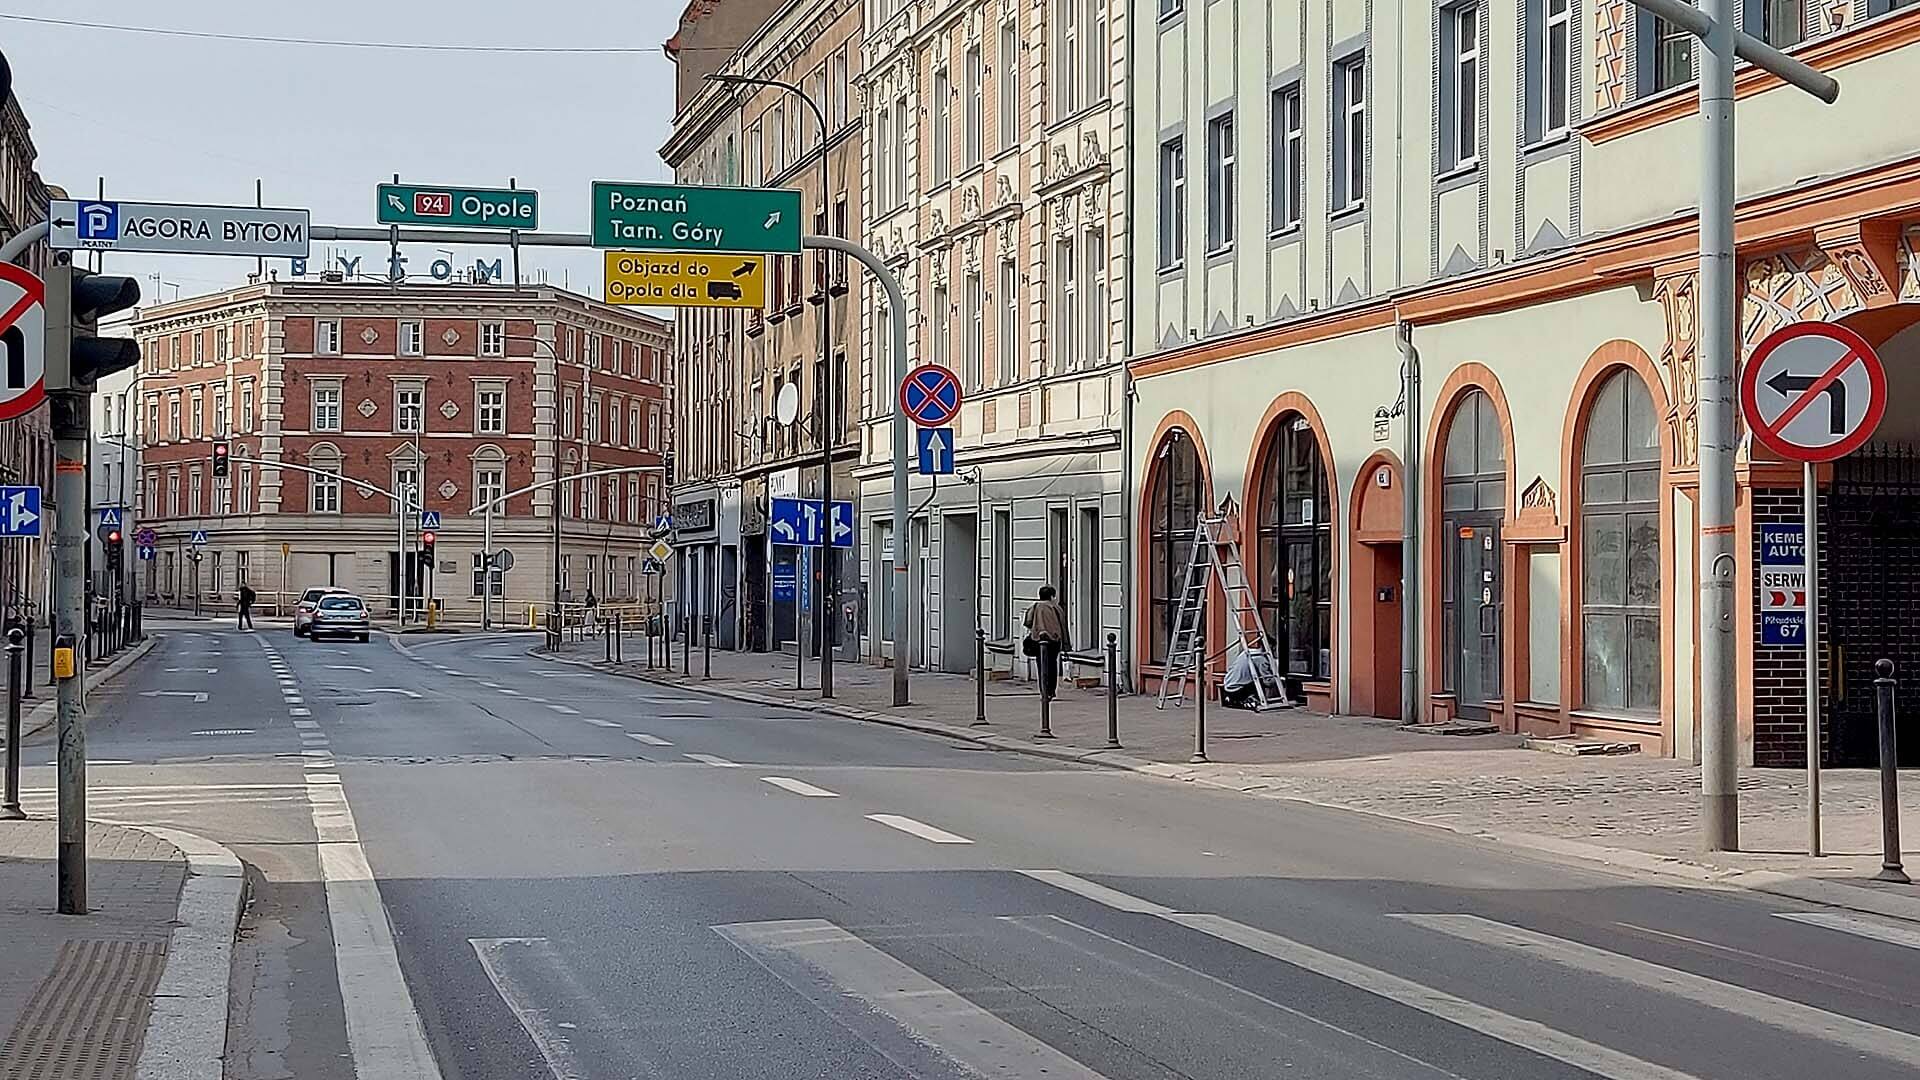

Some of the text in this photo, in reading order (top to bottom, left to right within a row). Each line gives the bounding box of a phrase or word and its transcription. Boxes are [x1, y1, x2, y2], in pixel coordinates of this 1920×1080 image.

[422, 196, 532, 222] 94 Opole
[610, 191, 687, 213] Poznań
[124, 217, 302, 243] AGORA BYTOM
[610, 219, 723, 246] Tarn. Góry
[618, 258, 709, 278] Objazd do
[609, 281, 697, 300] Opola dla
[1780, 624, 1799, 638] 67
